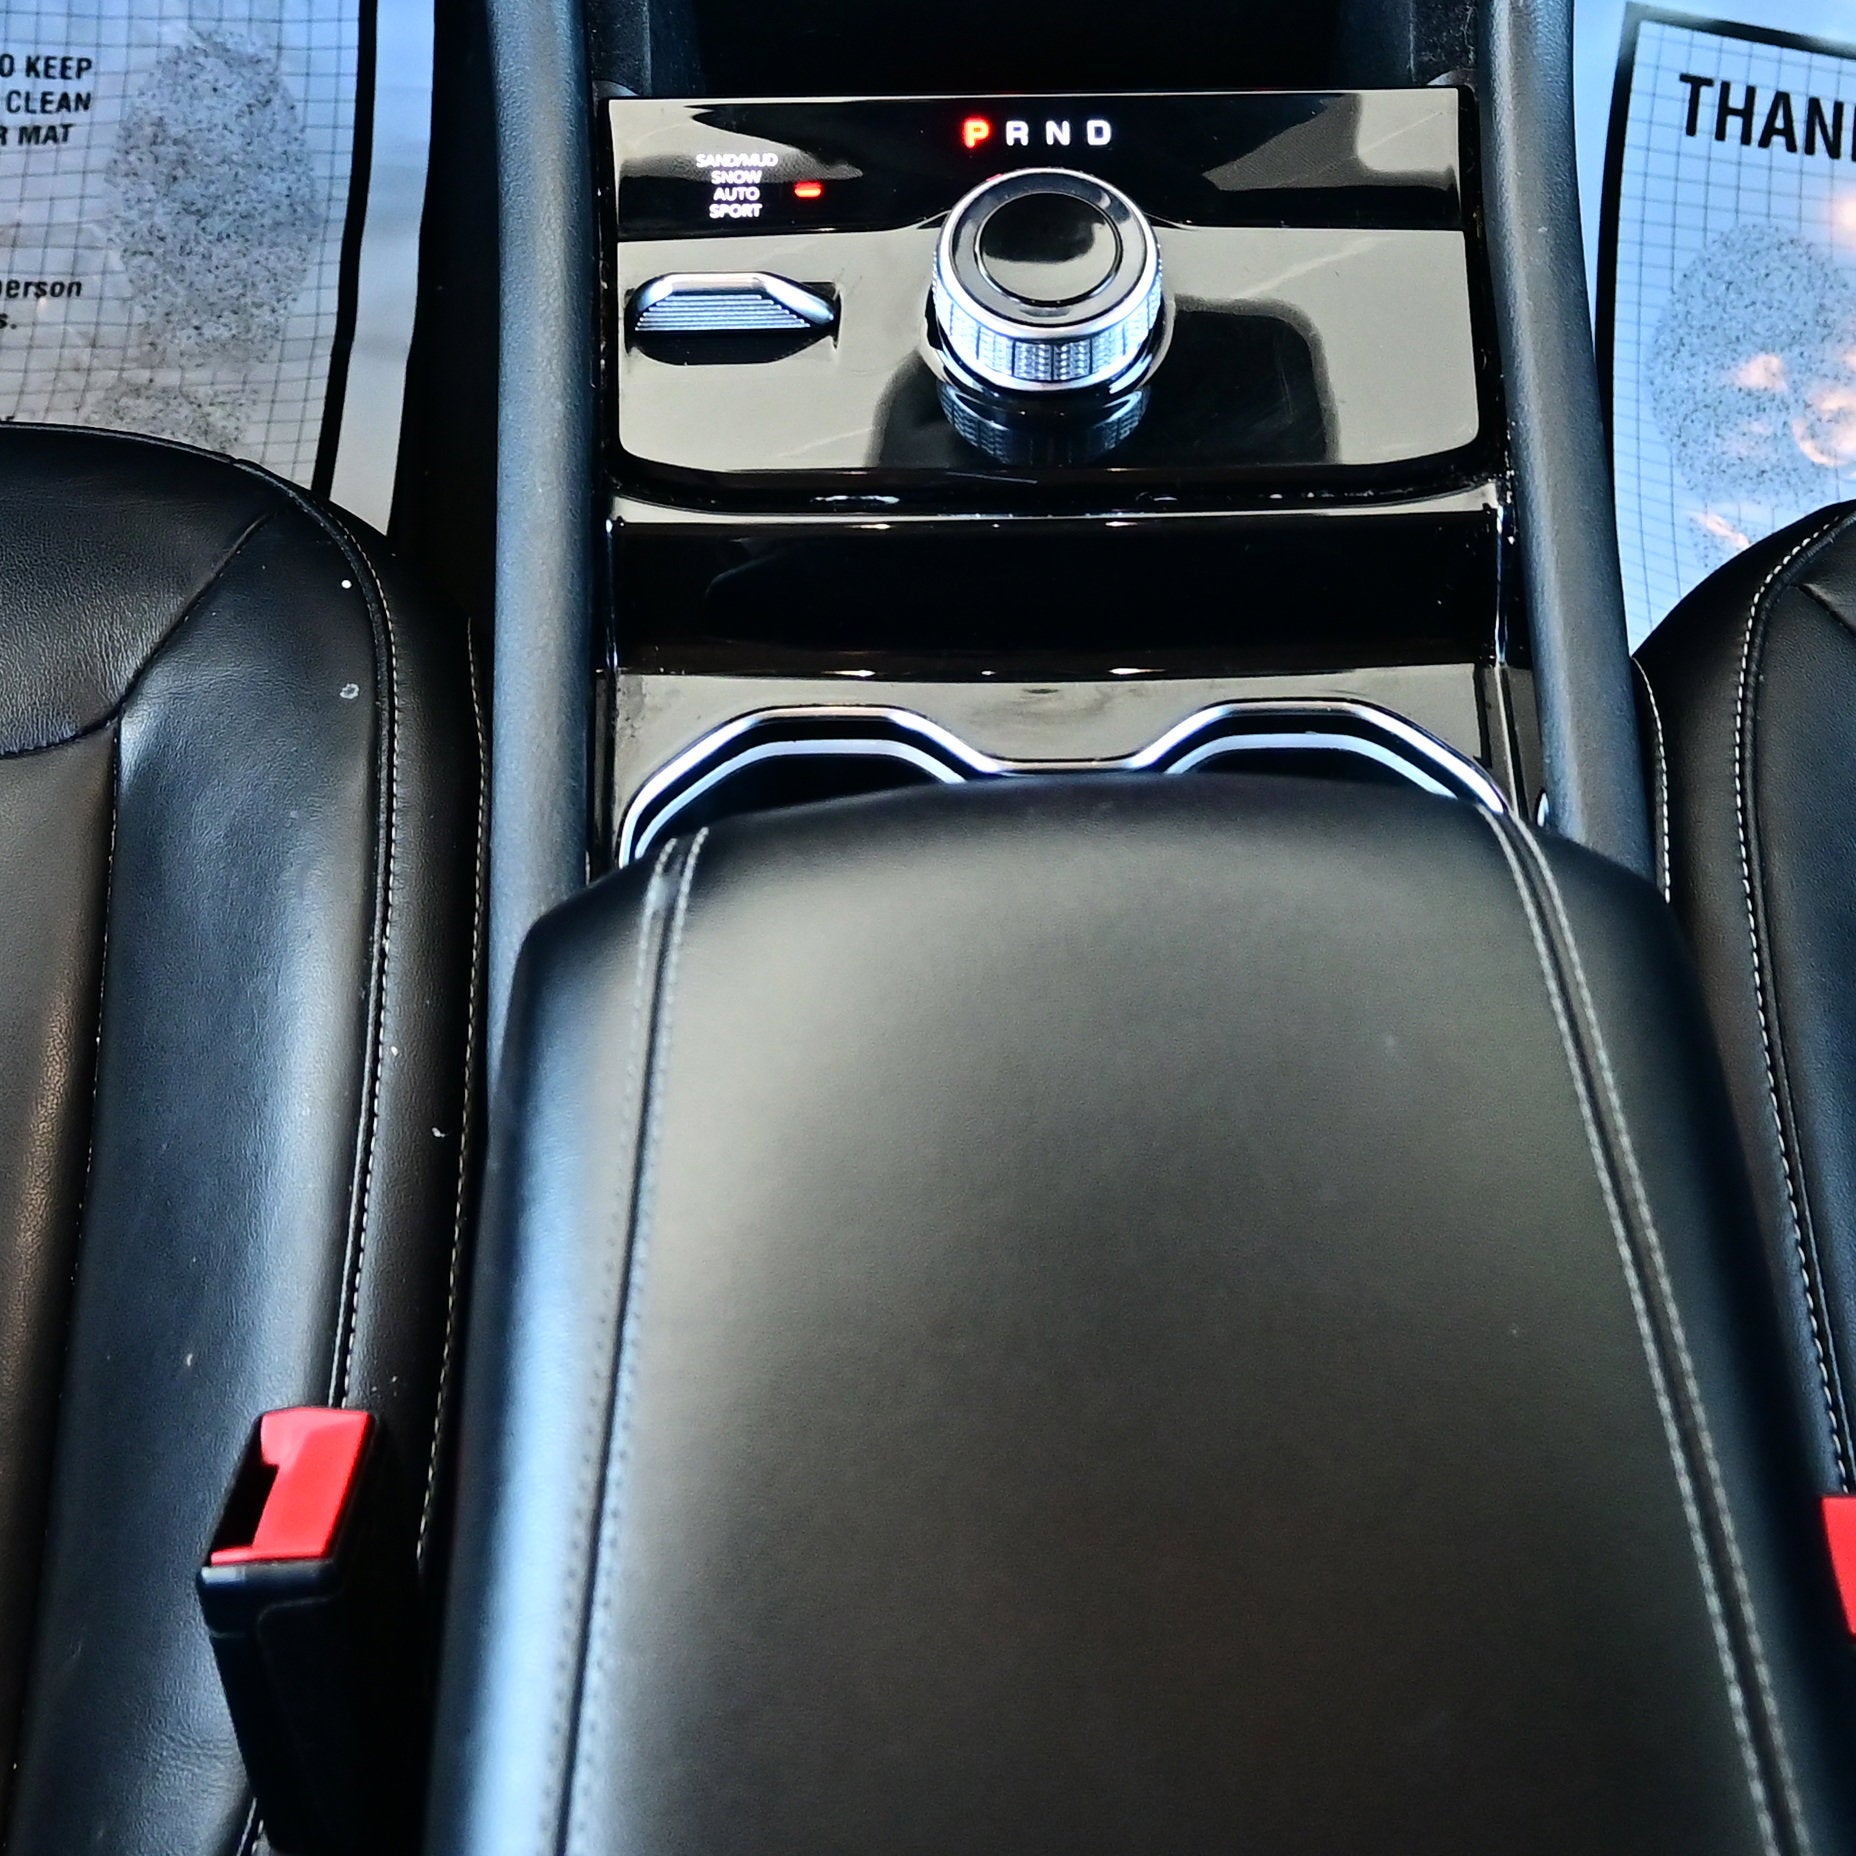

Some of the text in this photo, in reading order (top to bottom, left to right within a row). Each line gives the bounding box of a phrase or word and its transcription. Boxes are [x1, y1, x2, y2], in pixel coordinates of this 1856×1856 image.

[25, 54, 93, 80] KEEP
[6, 90, 92, 114] CLEAN
[17, 123, 76, 145] MAT
[964, 117, 1112, 148] P R N D
[695, 153, 779, 169] SAND/MUD
[710, 170, 762, 184] SNOW
[712, 186, 760, 201] AUTO
[708, 203, 763, 219] SPORT
